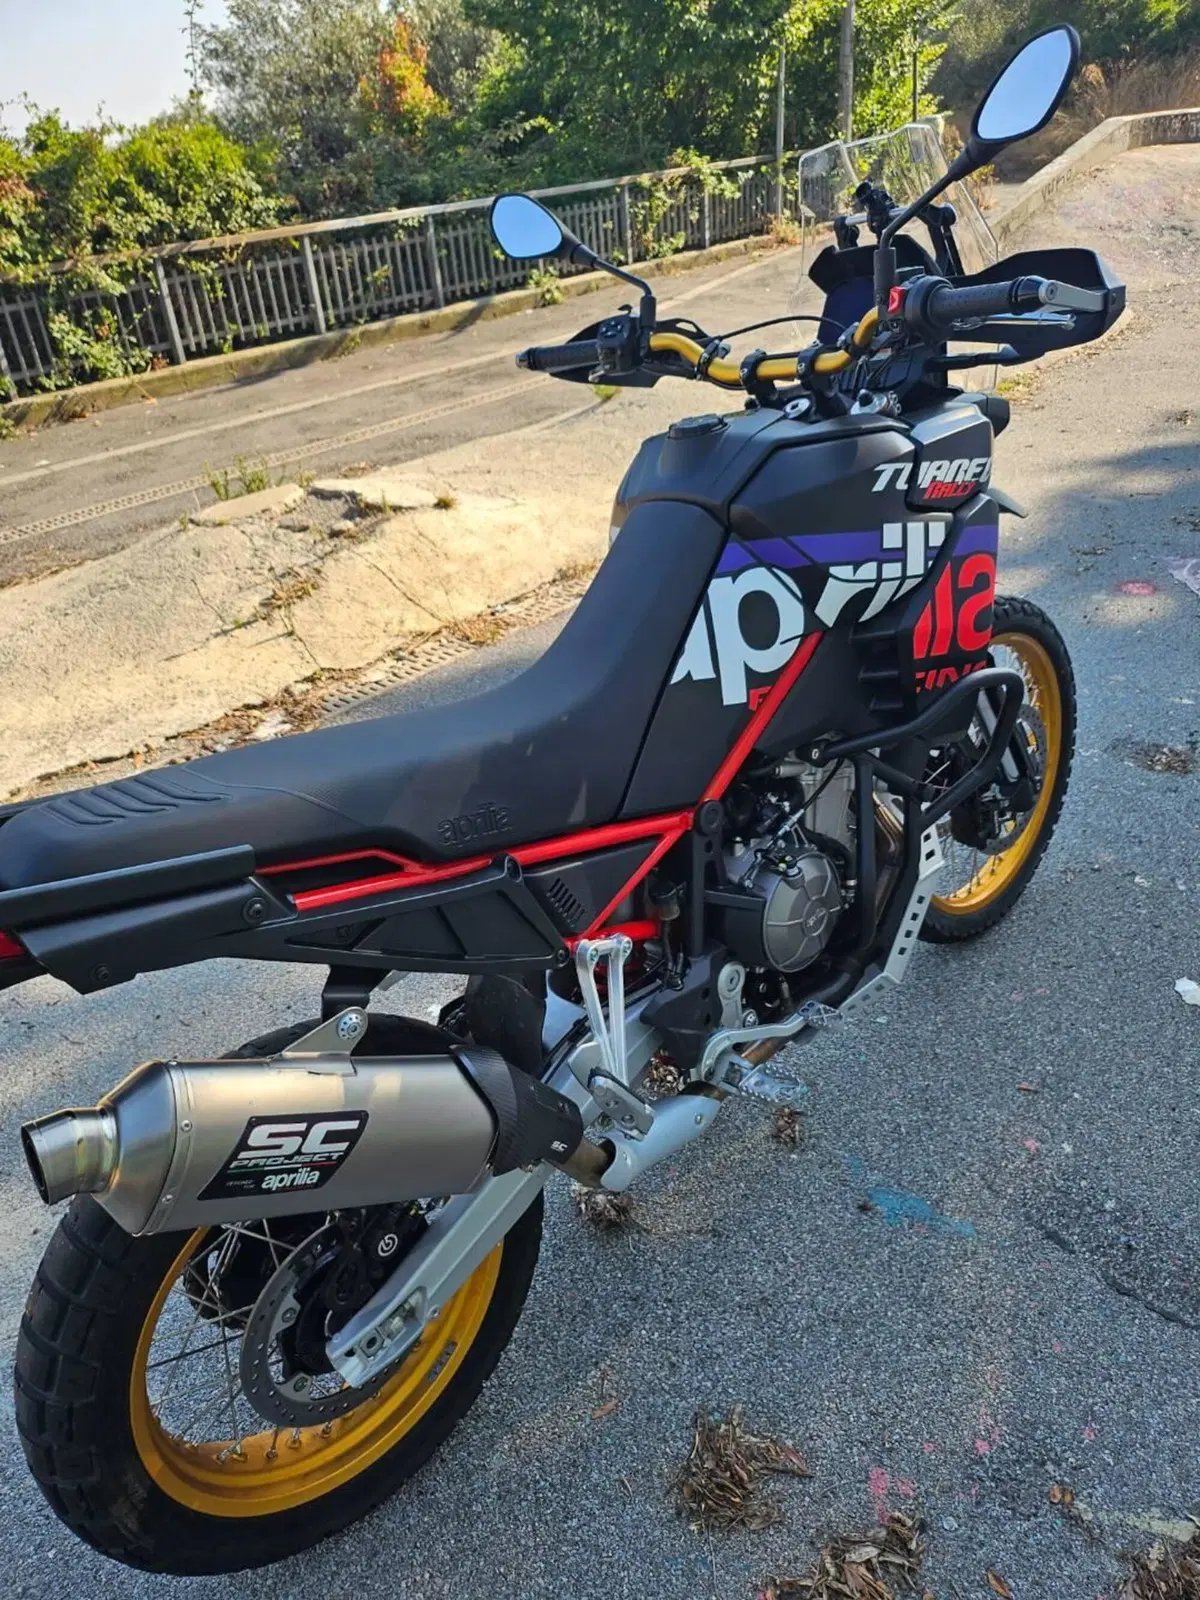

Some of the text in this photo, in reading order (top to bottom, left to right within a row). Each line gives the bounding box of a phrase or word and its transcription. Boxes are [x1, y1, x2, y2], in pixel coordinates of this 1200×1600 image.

[923, 481, 975, 499] RALLY
[438, 801, 510, 847] aprilia
[238, 1120, 360, 1159] SC
[229, 1152, 344, 1168] PROJECT
[261, 1167, 320, 1190] aprilia
